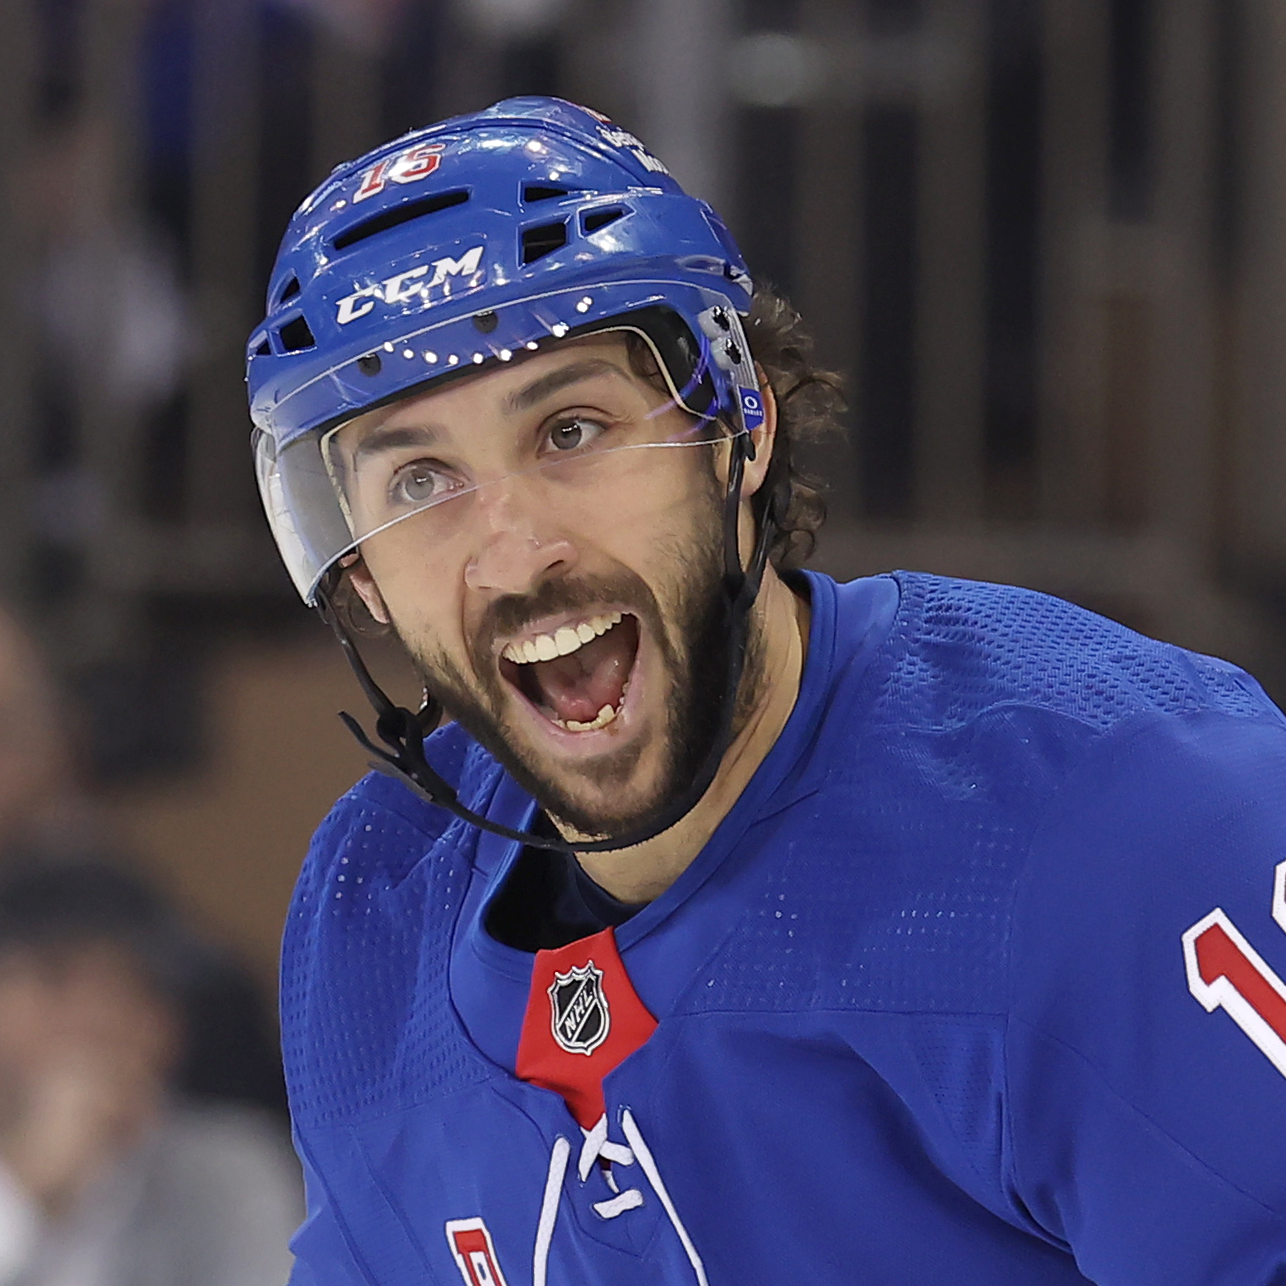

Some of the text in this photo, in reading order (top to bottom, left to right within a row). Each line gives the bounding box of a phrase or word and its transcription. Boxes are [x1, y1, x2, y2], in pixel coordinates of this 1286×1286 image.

[353, 143, 447, 205] 16
[335, 245, 485, 325] CCM
[563, 986, 594, 1039] NHL
